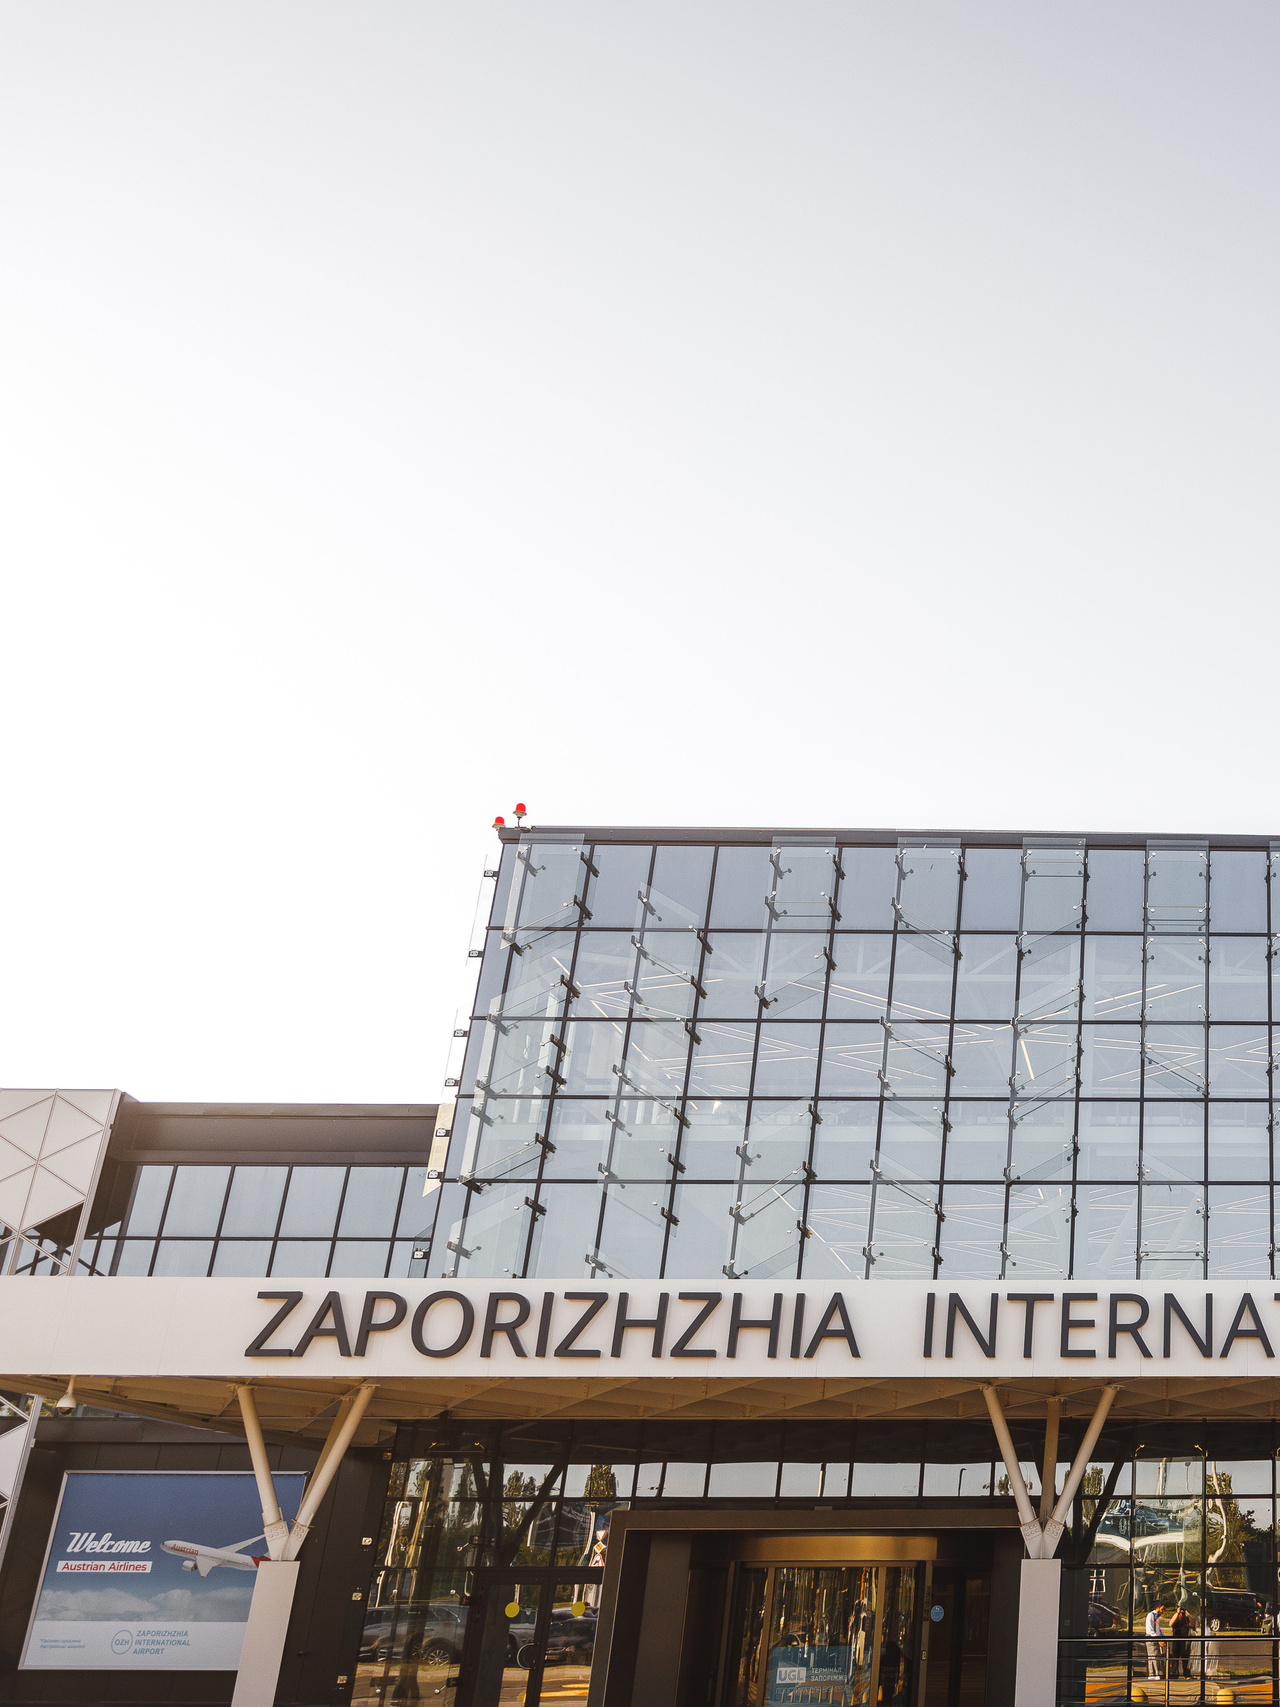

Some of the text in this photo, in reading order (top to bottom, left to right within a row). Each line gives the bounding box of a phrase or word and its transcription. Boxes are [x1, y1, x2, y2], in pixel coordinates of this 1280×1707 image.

[245, 1290, 861, 1358] ZAPORIZHZHIA
[66, 1532, 152, 1554] Welcome
[170, 1543, 199, 1556] Austrian
[61, 1561, 147, 1572] Austrian Airlines
[778, 1669, 804, 1682] UGL
